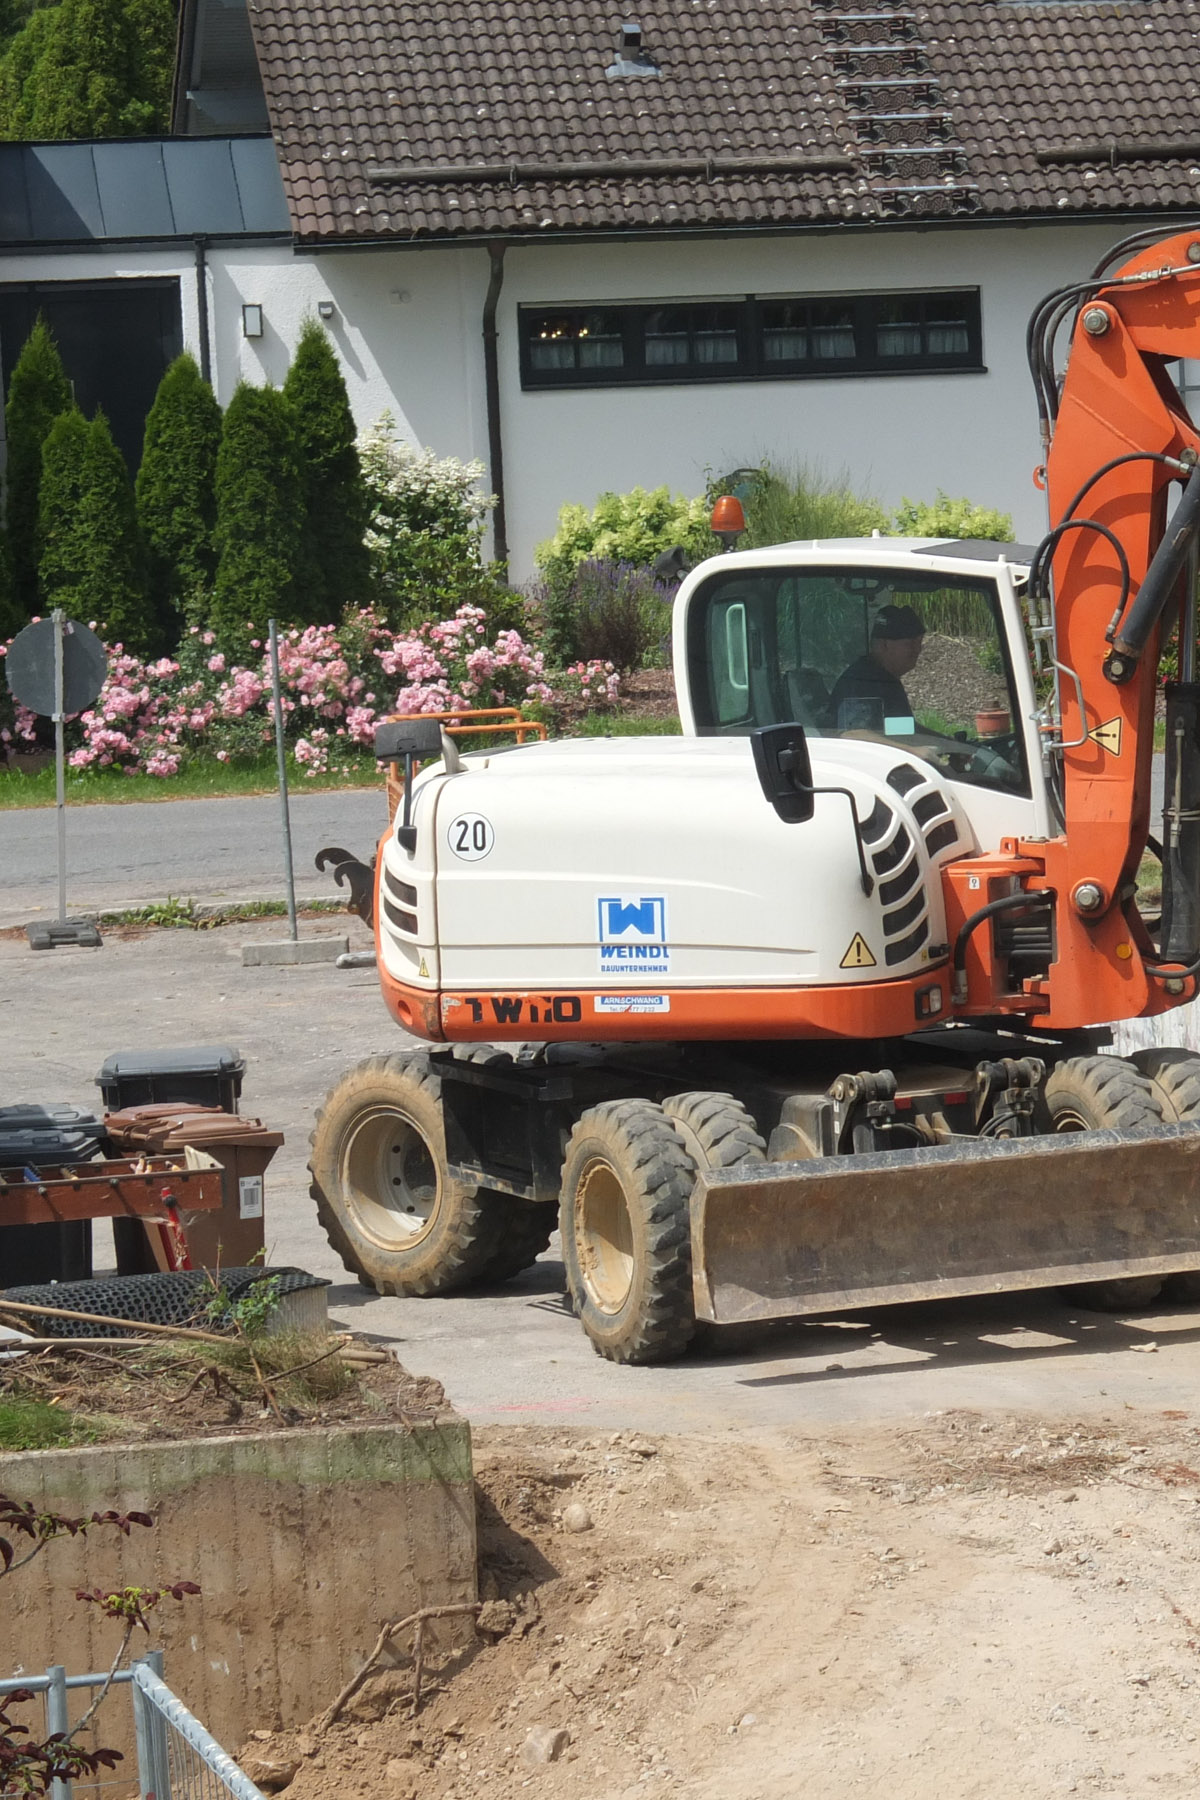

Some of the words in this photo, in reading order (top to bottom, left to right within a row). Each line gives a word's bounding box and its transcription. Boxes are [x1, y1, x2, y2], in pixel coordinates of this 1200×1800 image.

[456, 820, 486, 851] 20
[600, 945, 670, 959] WEINDL
[601, 964, 668, 973] BAUUNTERNEHMEN
